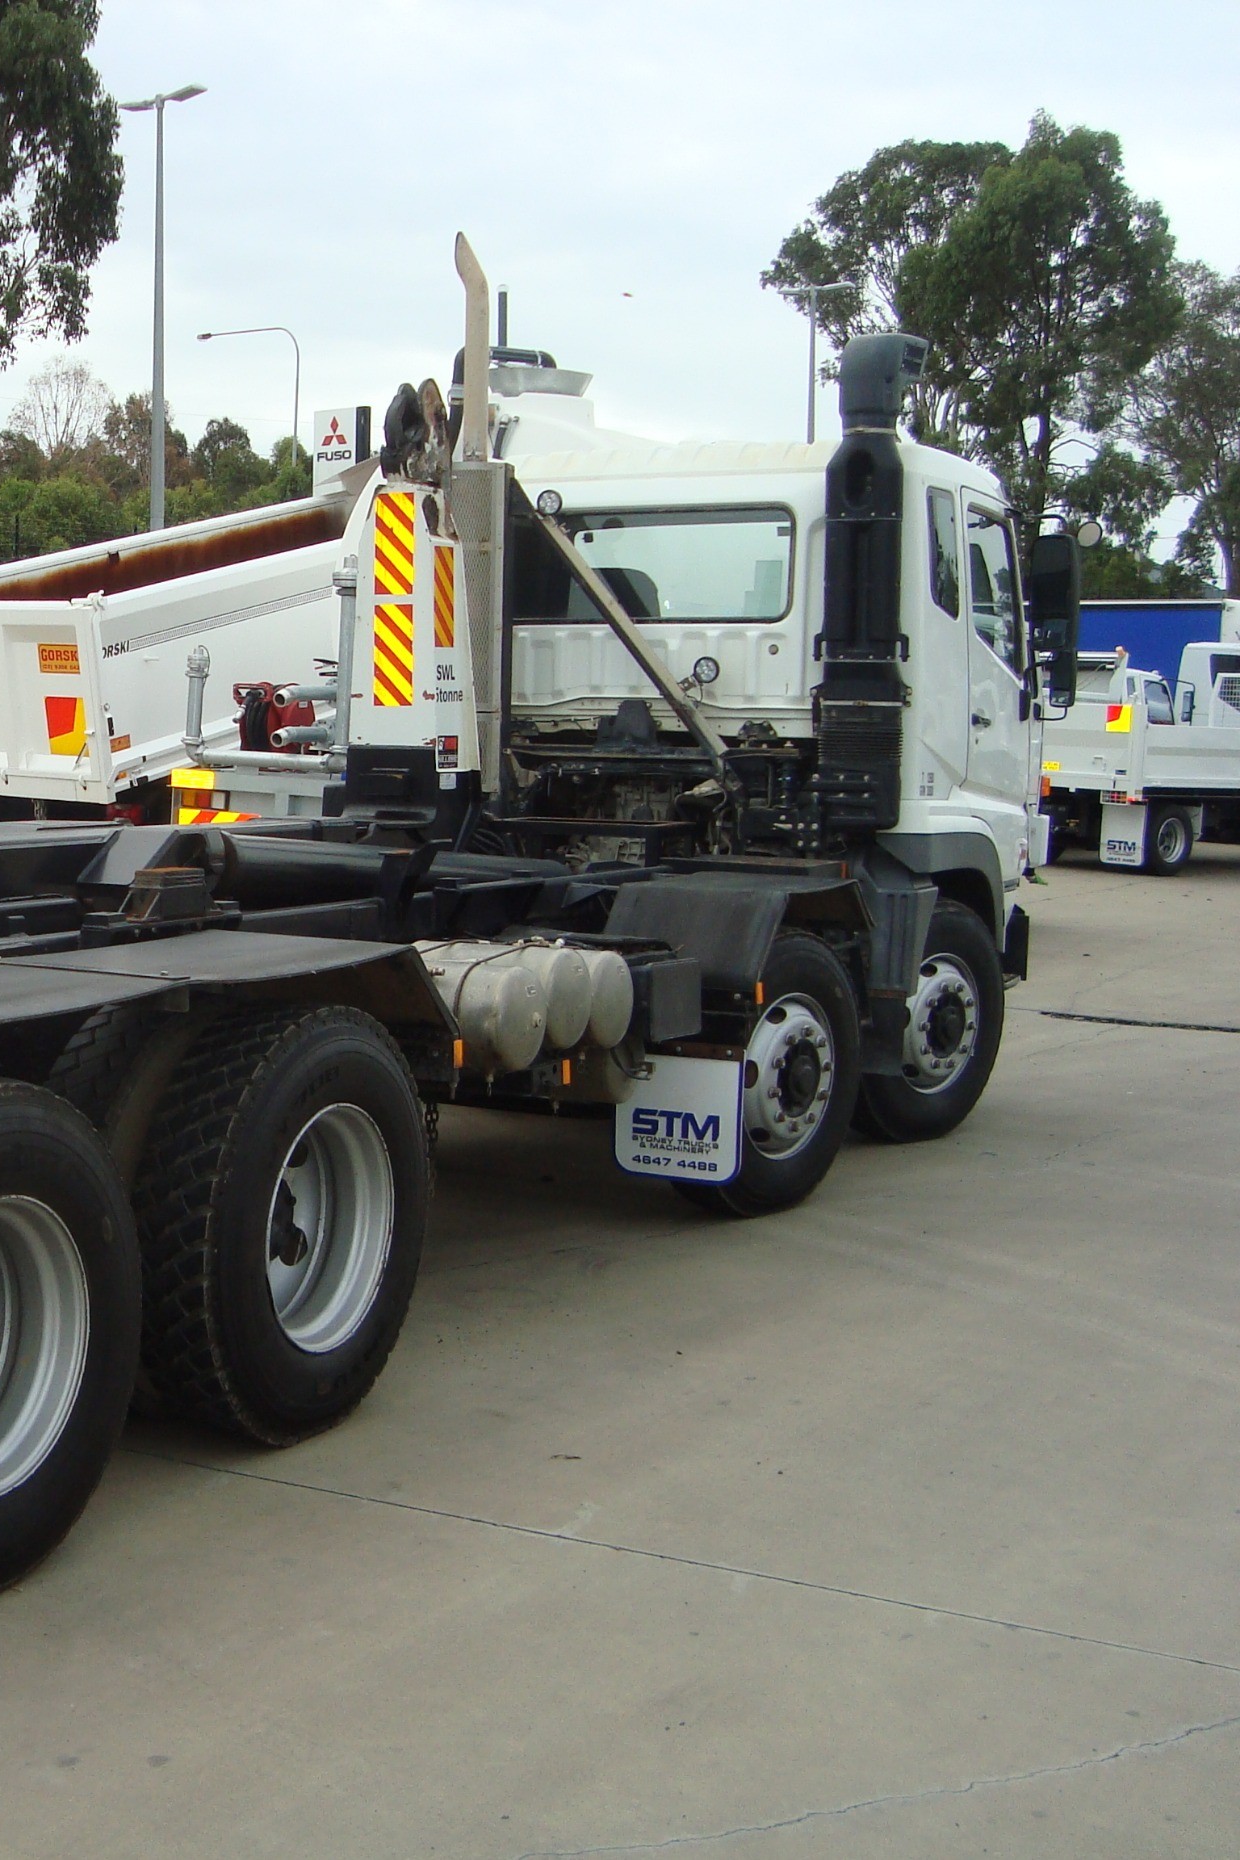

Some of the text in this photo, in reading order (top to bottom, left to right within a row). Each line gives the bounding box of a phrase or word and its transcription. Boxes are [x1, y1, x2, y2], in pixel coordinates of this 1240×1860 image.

[317, 450, 352, 463] FUSO
[41, 648, 79, 662] GORSK
[436, 664, 456, 681] SWL
[1107, 840, 1136, 852] STM
[632, 1107, 720, 1142] STM
[632, 1134, 719, 1150] SYDNEY TRUCKS
[650, 1142, 711, 1155] MACHINERY
[632, 1154, 718, 1172] 4647 4488
